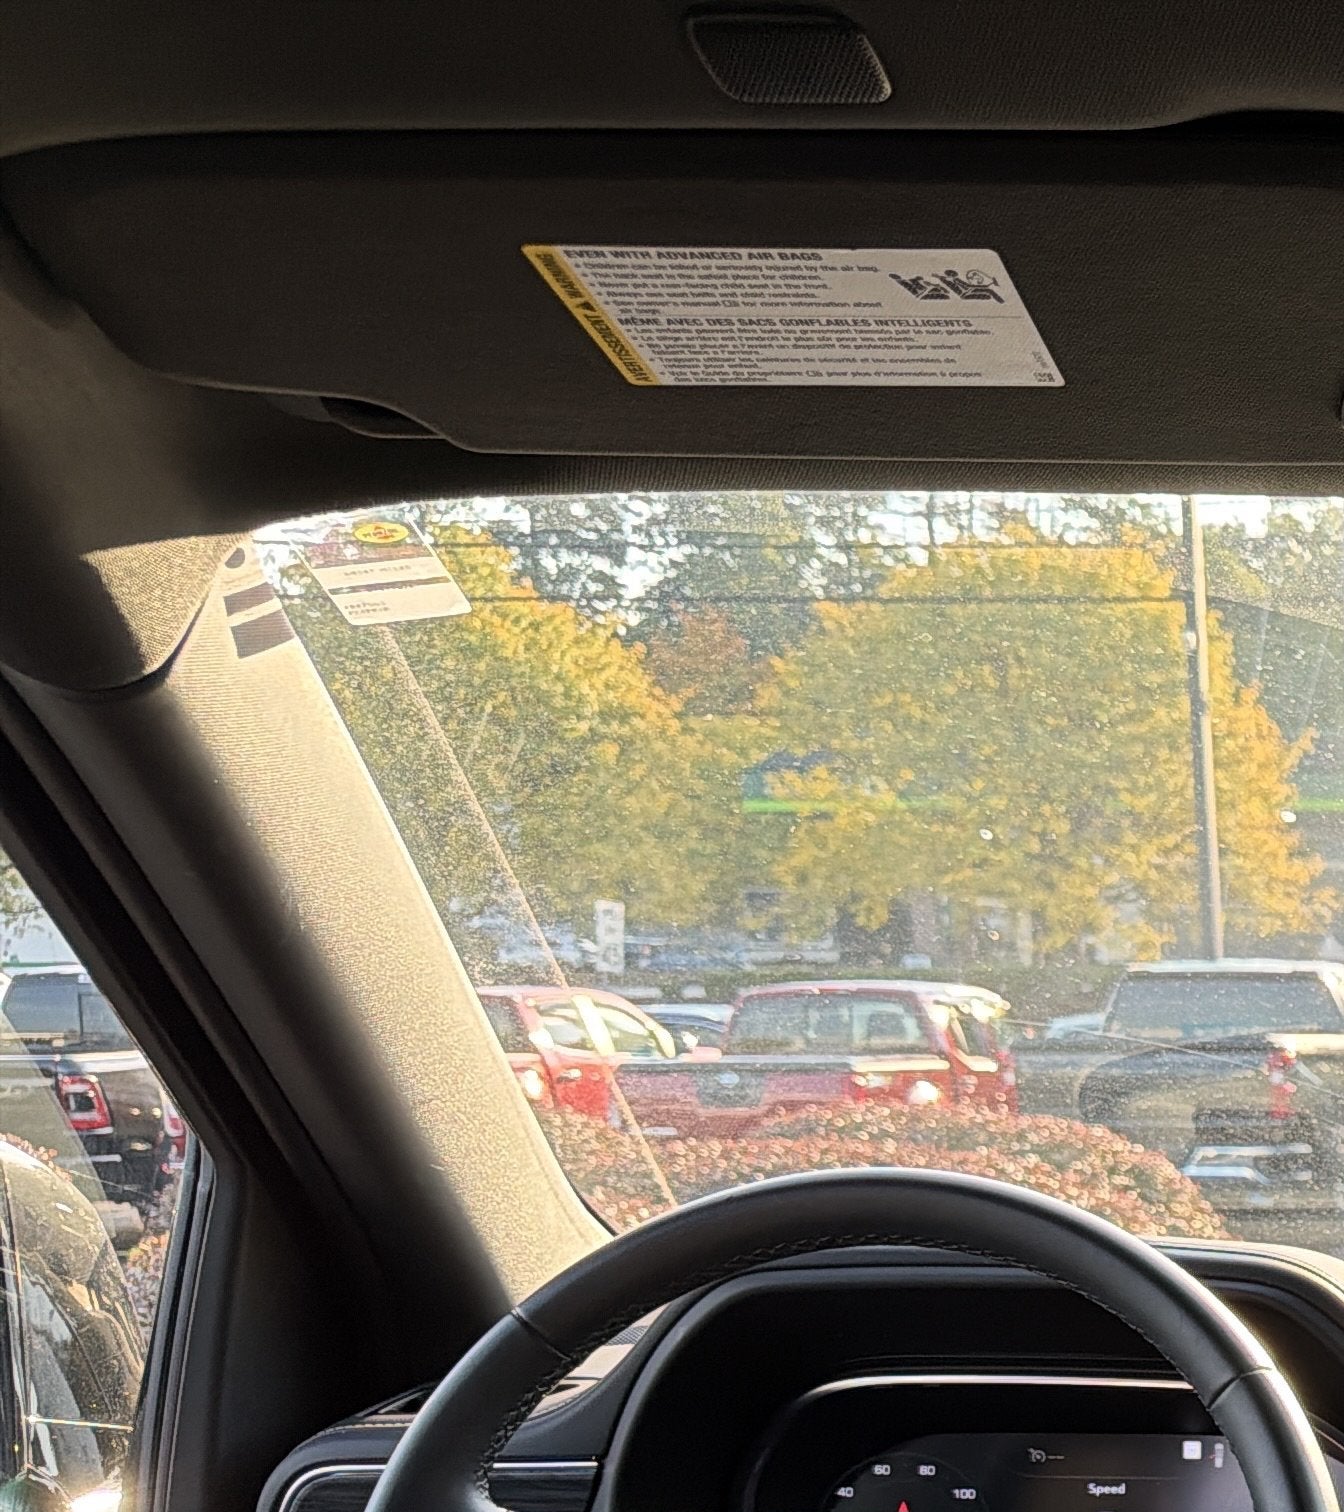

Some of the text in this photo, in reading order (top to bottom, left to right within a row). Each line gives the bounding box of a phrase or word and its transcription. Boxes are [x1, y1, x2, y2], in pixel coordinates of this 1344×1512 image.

[561, 249, 824, 260] EVEN WITH ADVANCED AIR BAGS
[613, 314, 974, 327] MÊME AVEC DES SACS GONFLABLES INTELLIGENTS
[873, 1464, 891, 1476] 60
[919, 1465, 936, 1476] 80
[837, 1487, 854, 1498] 40
[952, 1488, 976, 1500] 100
[1087, 1483, 1126, 1497] Speed
